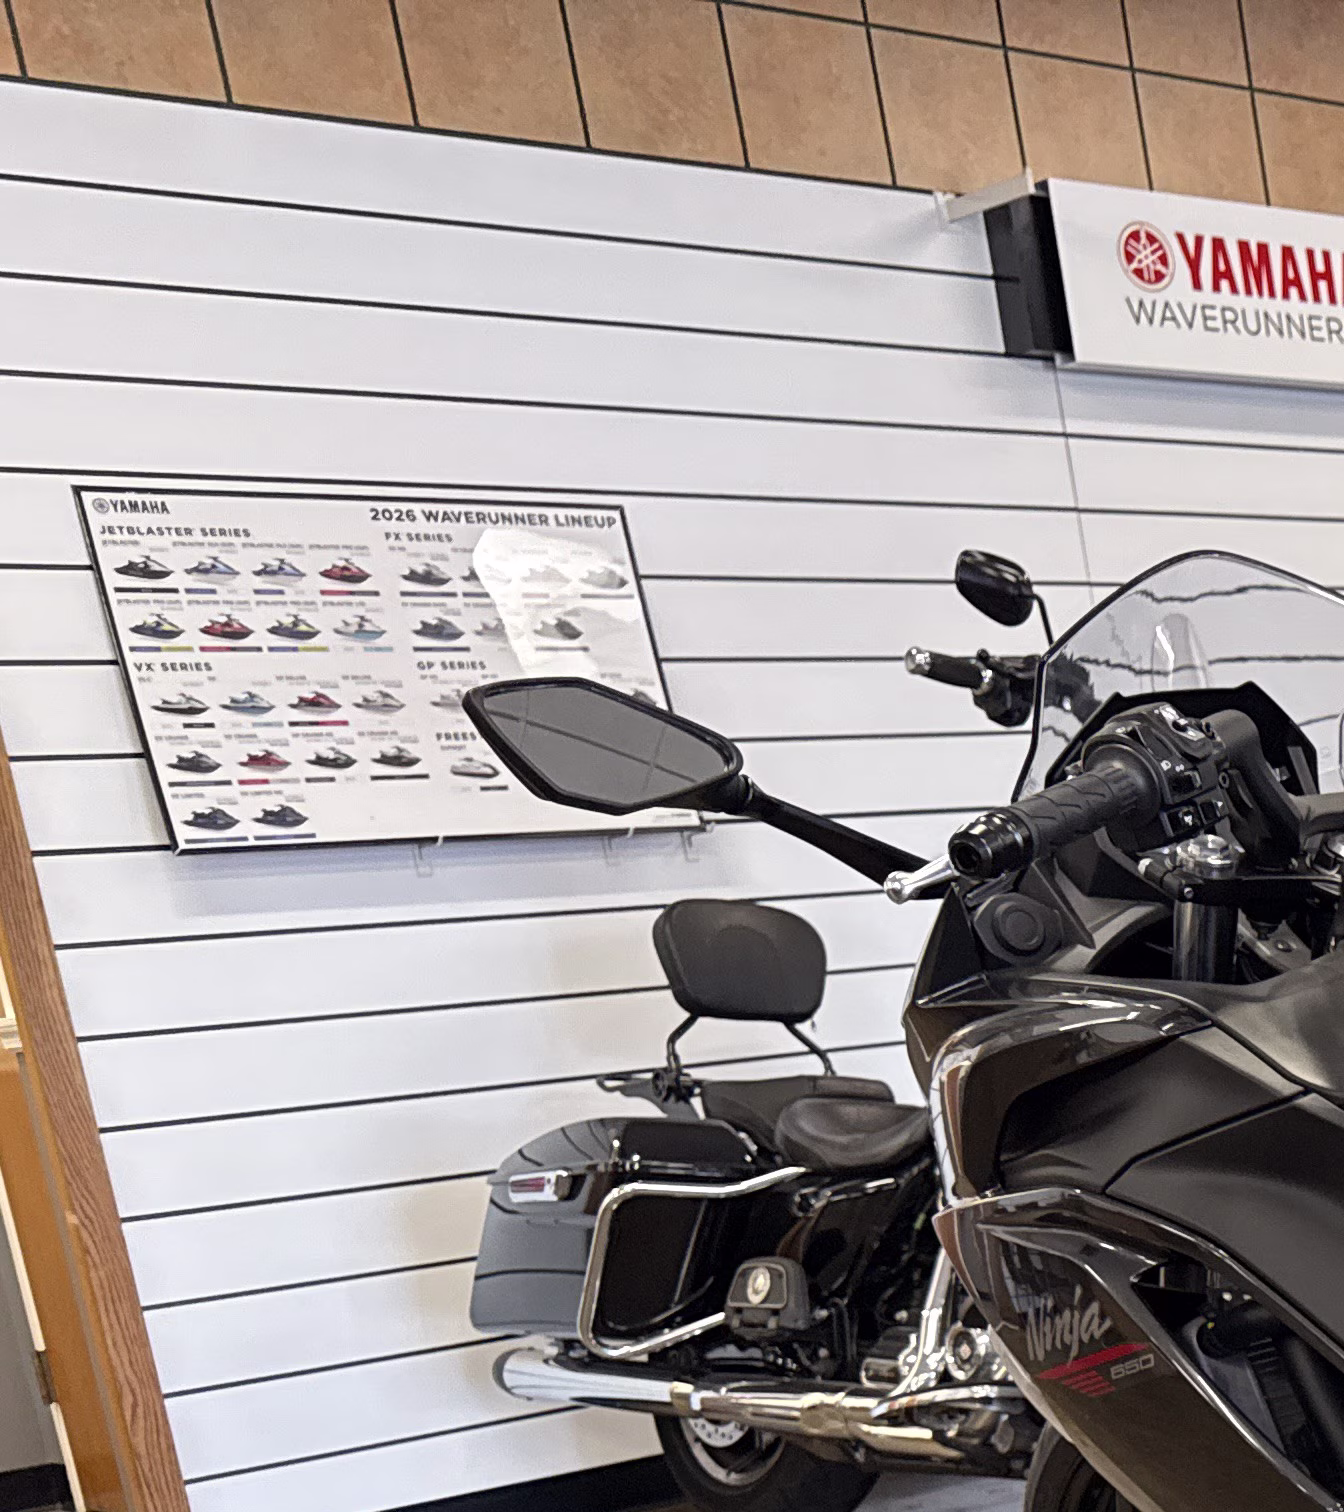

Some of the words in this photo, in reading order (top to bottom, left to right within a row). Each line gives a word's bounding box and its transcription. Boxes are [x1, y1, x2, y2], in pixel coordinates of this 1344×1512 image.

[109, 499, 171, 515] YAMAHA
[369, 507, 418, 523] 2026
[421, 509, 550, 528] WAVERUNNER
[554, 513, 617, 530] LINEUP
[99, 525, 195, 537] JETBLASTER
[200, 527, 251, 538] SERIES
[407, 532, 454, 543] SERIES
[160, 661, 213, 673] SERIES
[440, 660, 487, 671] SERIES
[1026, 1284, 1113, 1367] Ninja
[1110, 1353, 1155, 1380] 650
